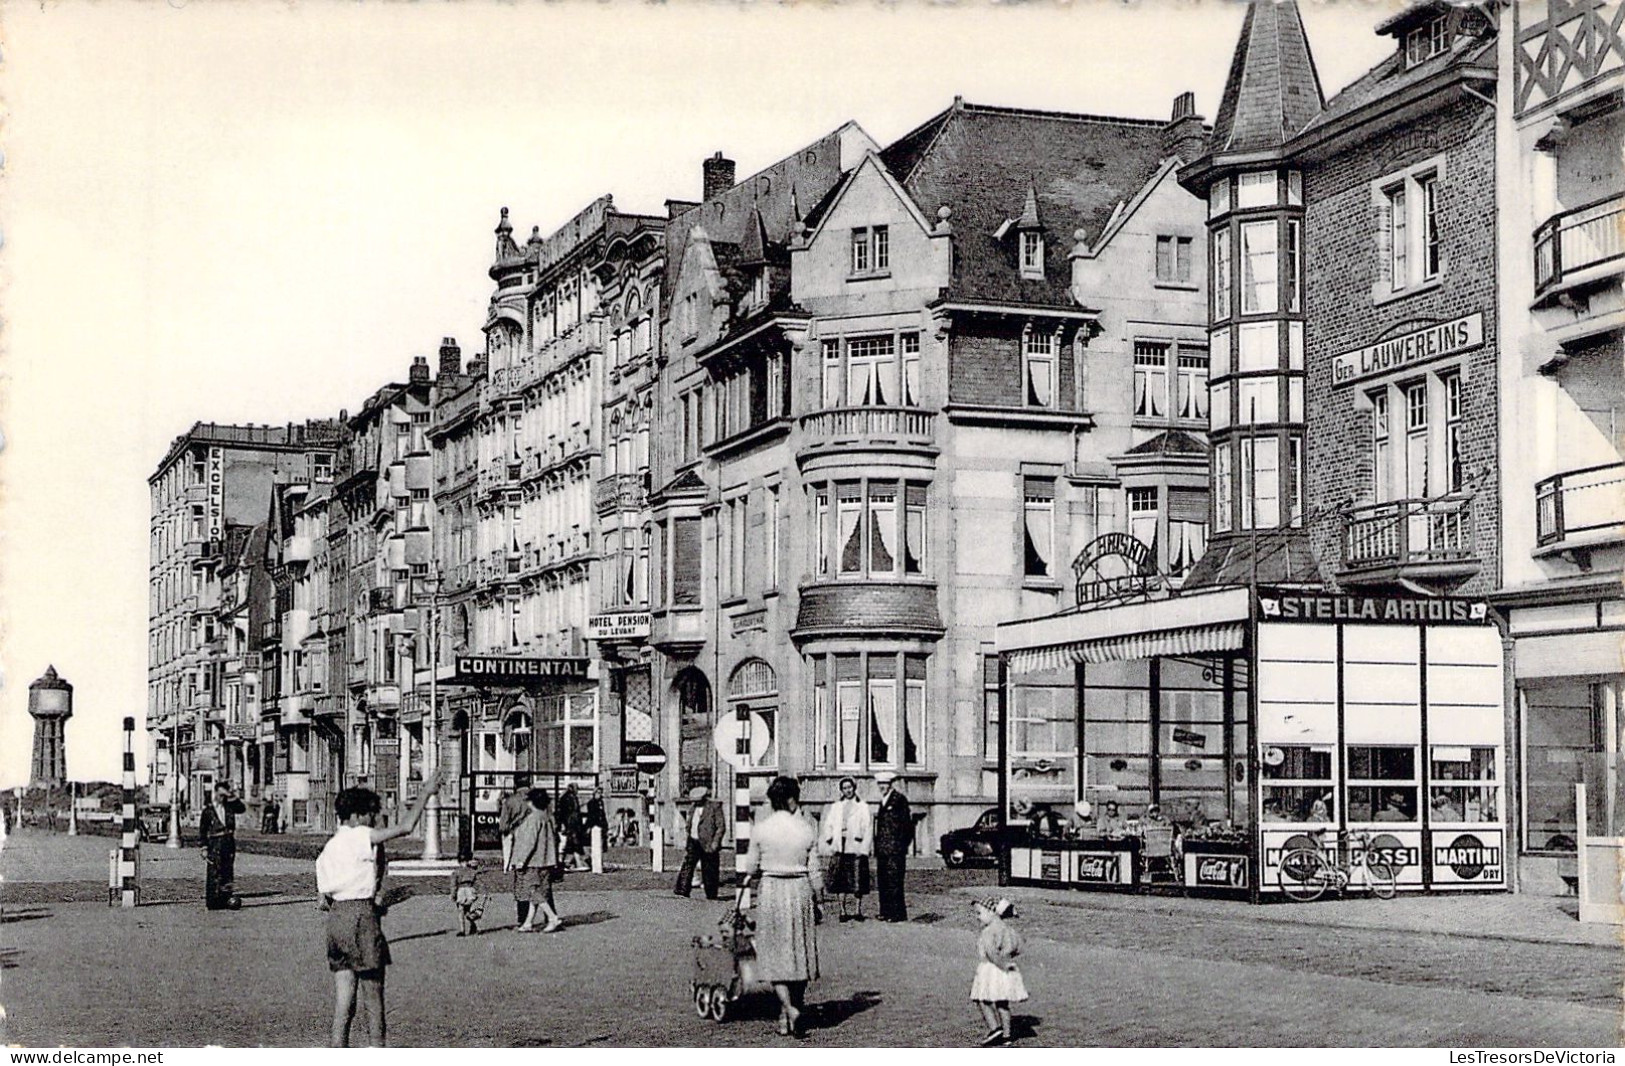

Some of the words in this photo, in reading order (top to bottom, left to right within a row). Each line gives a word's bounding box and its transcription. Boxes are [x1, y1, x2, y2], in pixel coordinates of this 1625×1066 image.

[1361, 321, 1469, 374] LAUWEREINS
[1282, 597, 1377, 619] STELLA
[1384, 599, 1467, 621] ARTOIS
[589, 617, 613, 628] HOTEL
[618, 615, 650, 626] PENSION
[611, 627, 636, 636] LEVANT
[459, 659, 585, 676] CONTINENTAL
[1353, 849, 1417, 866] ROSSI
[1436, 849, 1499, 865] MARTINI
[1483, 868, 1500, 881] DRY
